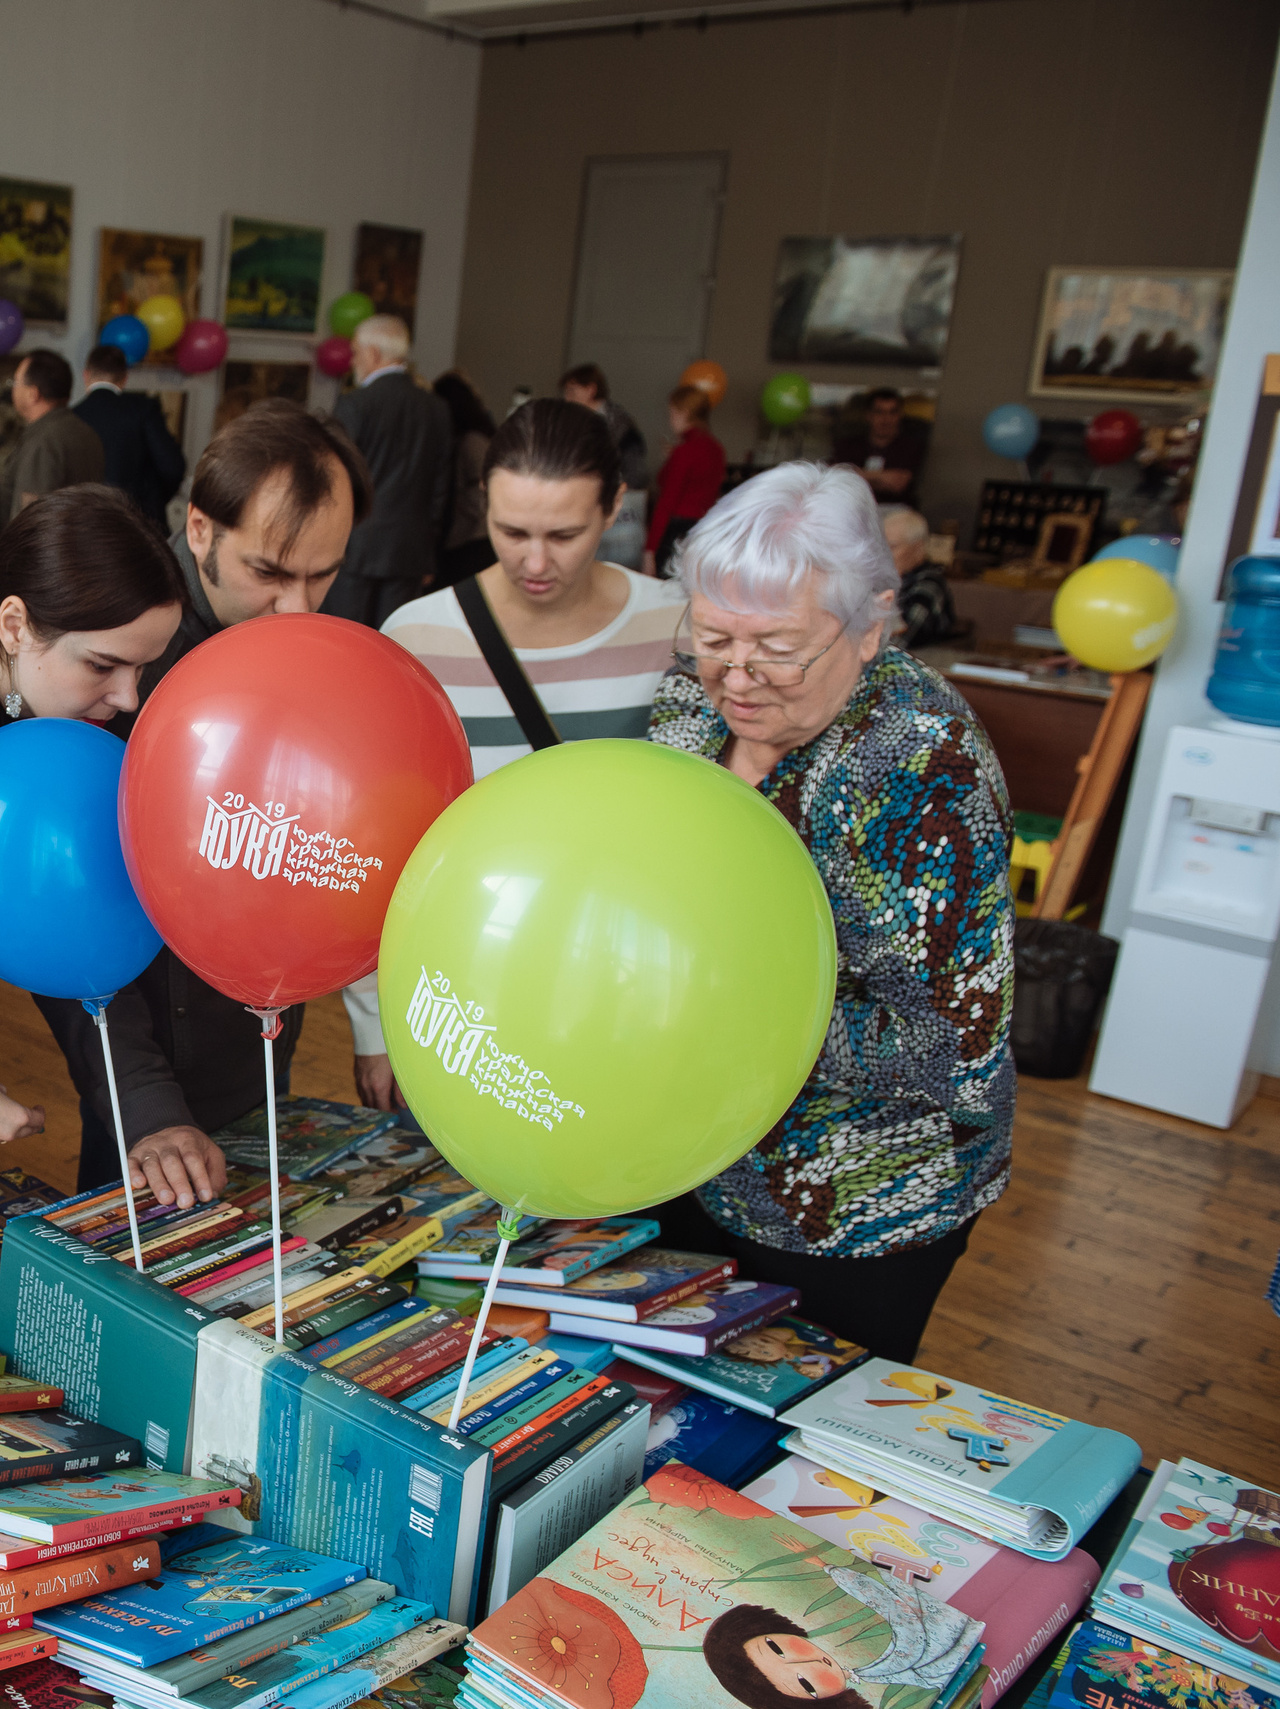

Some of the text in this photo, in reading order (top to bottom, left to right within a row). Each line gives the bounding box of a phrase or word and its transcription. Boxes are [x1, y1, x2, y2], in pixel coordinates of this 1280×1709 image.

[222, 791, 286, 818] 20 19
[285, 853, 367, 882] книжная
[289, 839, 383, 871] уральская
[282, 866, 360, 894] ярмарка
[431, 970, 486, 1022] 20 19
[473, 1060, 565, 1123] книжная
[478, 1047, 586, 1119] уральская
[469, 1072, 554, 1131] ярмарка
[283, 1315, 332, 1344] АКВАМАРИ
[327, 1338, 342, 1350] 42
[321, 1373, 361, 1398] Кольцо
[816, 1416, 968, 1477] Наш малыш
[534, 1456, 574, 1484] ОБЛАКО
[58, 1537, 97, 1556] СЕСТРЁНКА
[103, 1531, 122, 1542] БОБО
[608, 1532, 660, 1567] чудес
[645, 1516, 745, 1574] МАНУЭЛЫ АДРЕАНИ
[37, 1548, 57, 1560] БИБИ
[286, 1592, 312, 1608] Франсуа
[571, 1572, 661, 1627] ЛЬЮИС КЭРРОЛЛ
[593, 1547, 712, 1631] АЛИСА
[670, 1565, 734, 1607] Стране
[1189, 1569, 1280, 1606] ДНИК
[82, 1600, 150, 1627] ВСЕХНА
[988, 1602, 1070, 1696] Наша малышка
